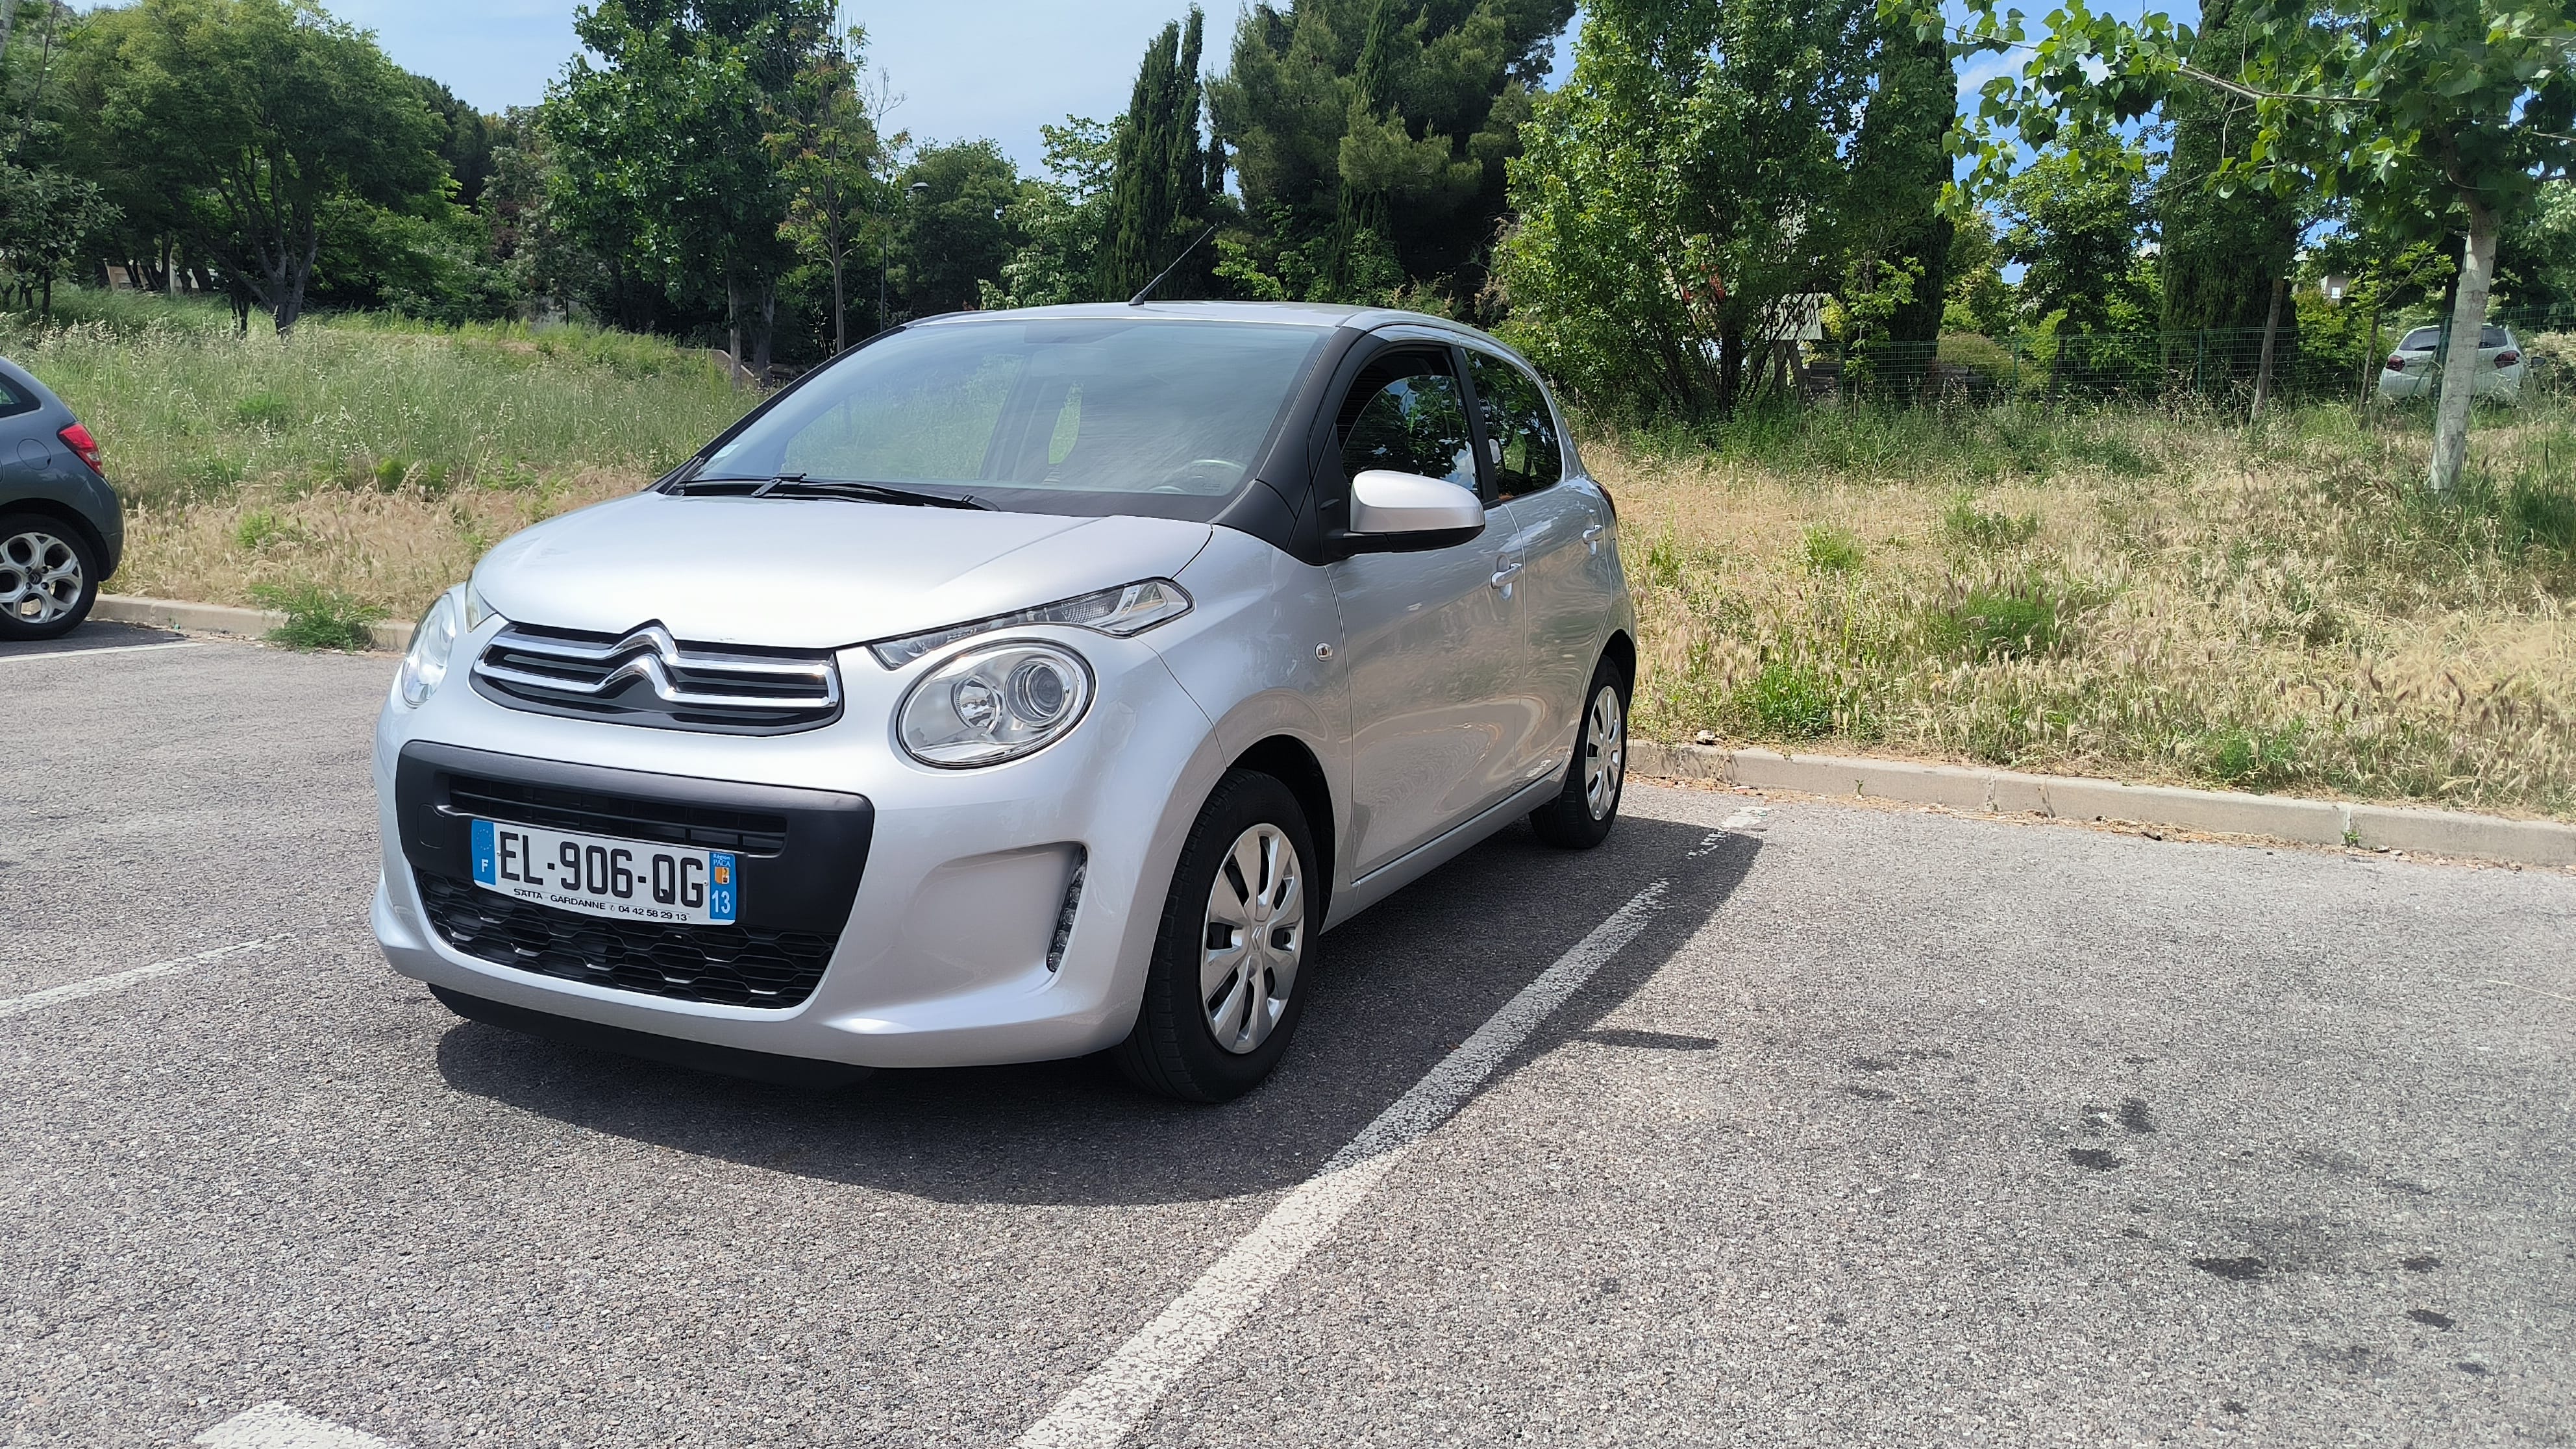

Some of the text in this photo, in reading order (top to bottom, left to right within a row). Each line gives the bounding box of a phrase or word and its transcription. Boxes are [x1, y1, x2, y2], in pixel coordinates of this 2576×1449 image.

[481, 858, 489, 873] F
[499, 831, 704, 908] EL-906-QG
[713, 859, 731, 868] PACA
[514, 888, 543, 900] SATTA
[550, 894, 606, 910] GARDANNE
[618, 905, 630, 913] 04
[646, 909, 658, 917] 58
[660, 911, 673, 919] 29
[675, 913, 687, 921] 13
[712, 889, 731, 914] 13
